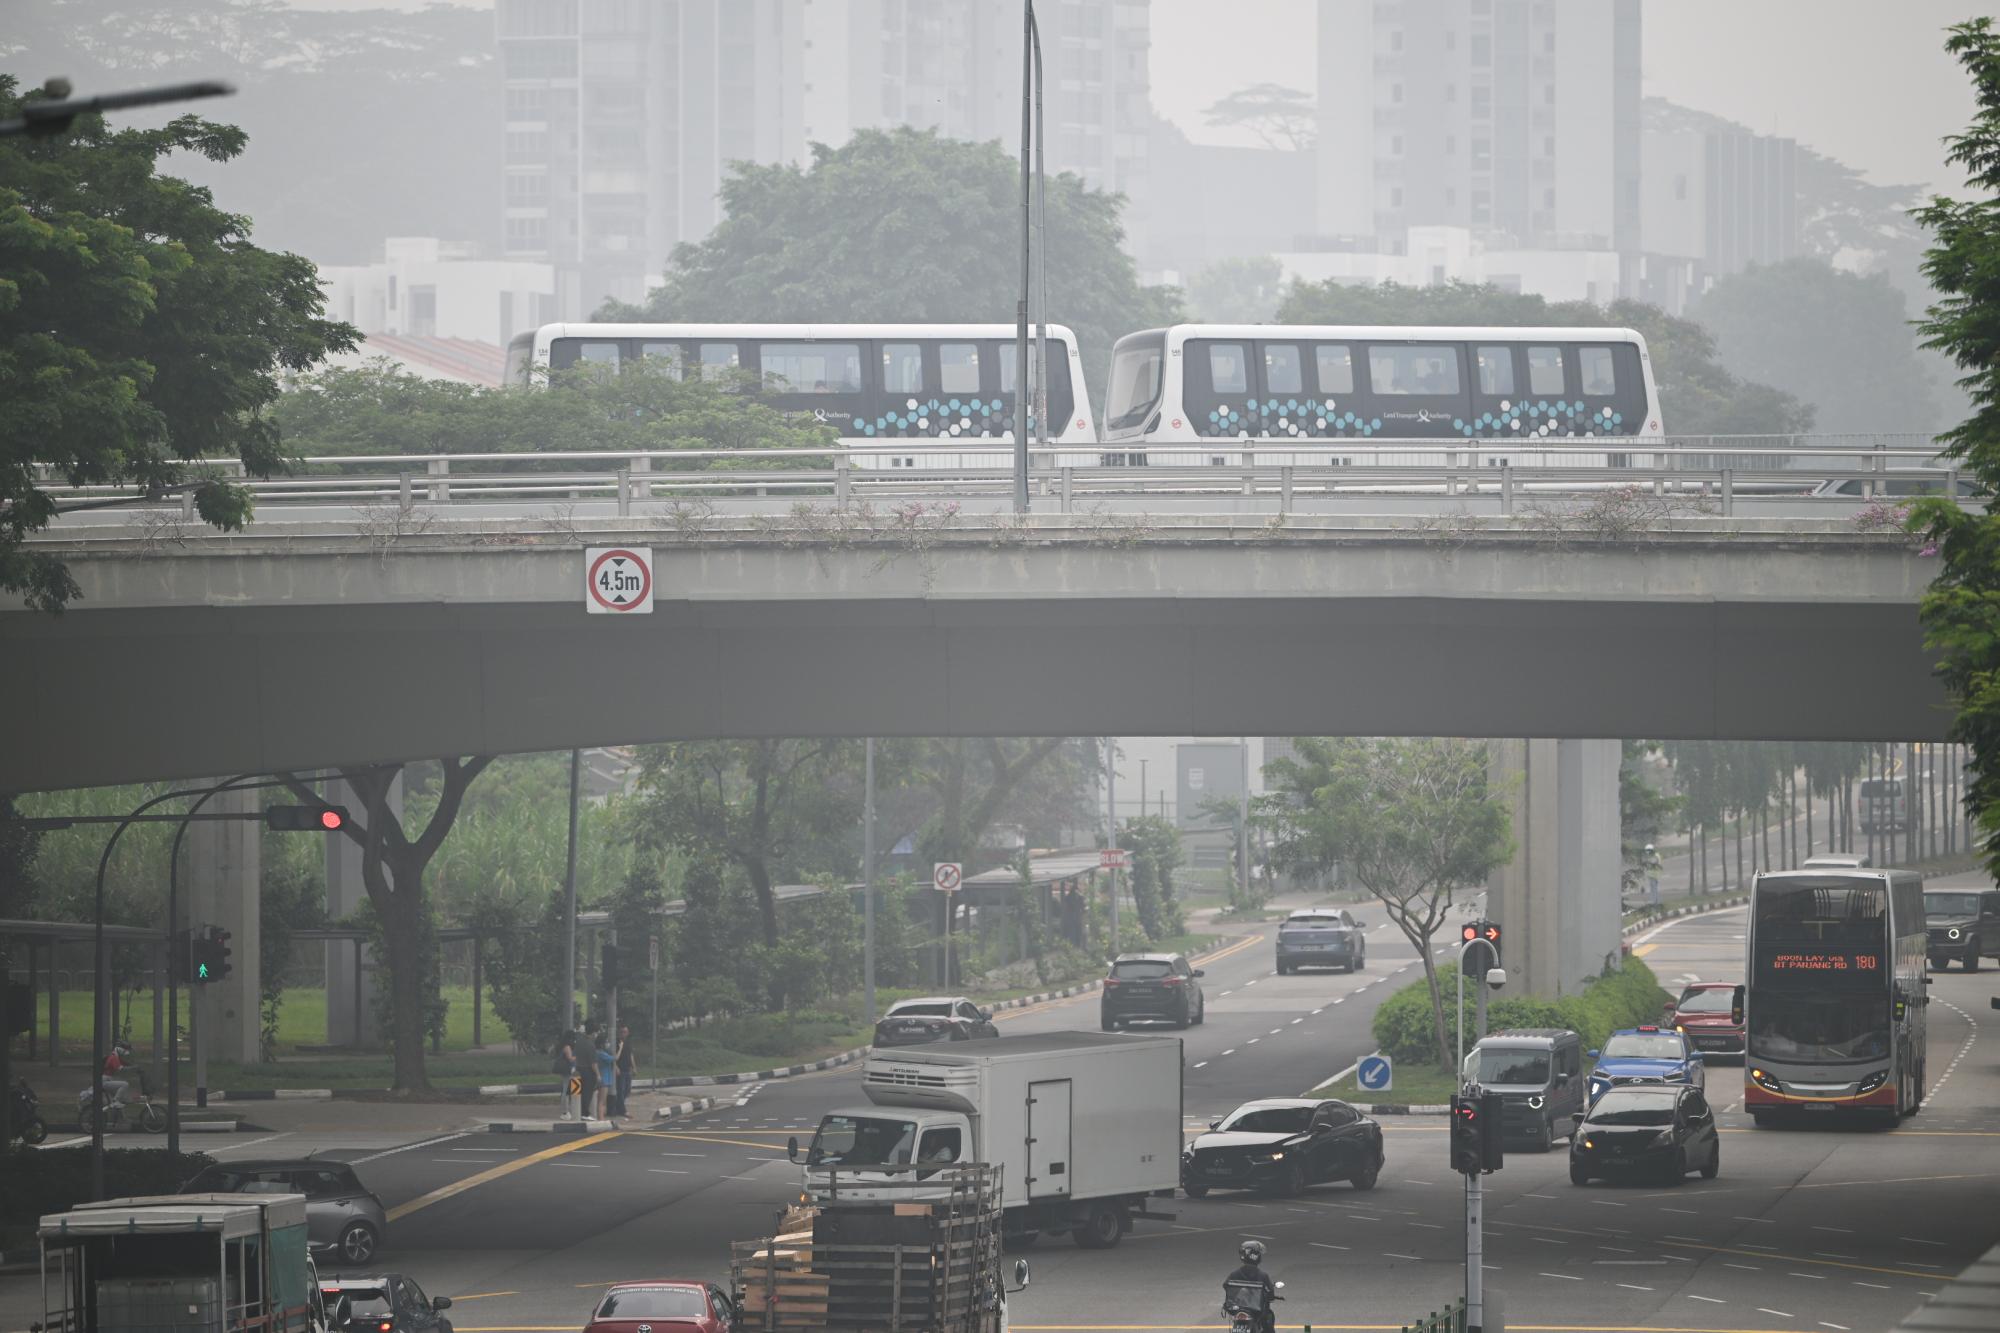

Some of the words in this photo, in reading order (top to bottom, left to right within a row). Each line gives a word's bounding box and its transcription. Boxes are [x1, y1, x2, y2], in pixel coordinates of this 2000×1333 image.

[600, 571, 640, 591] 4.5m
[1101, 853, 1124, 865] SLOW
[1856, 955, 1876, 969] 180
